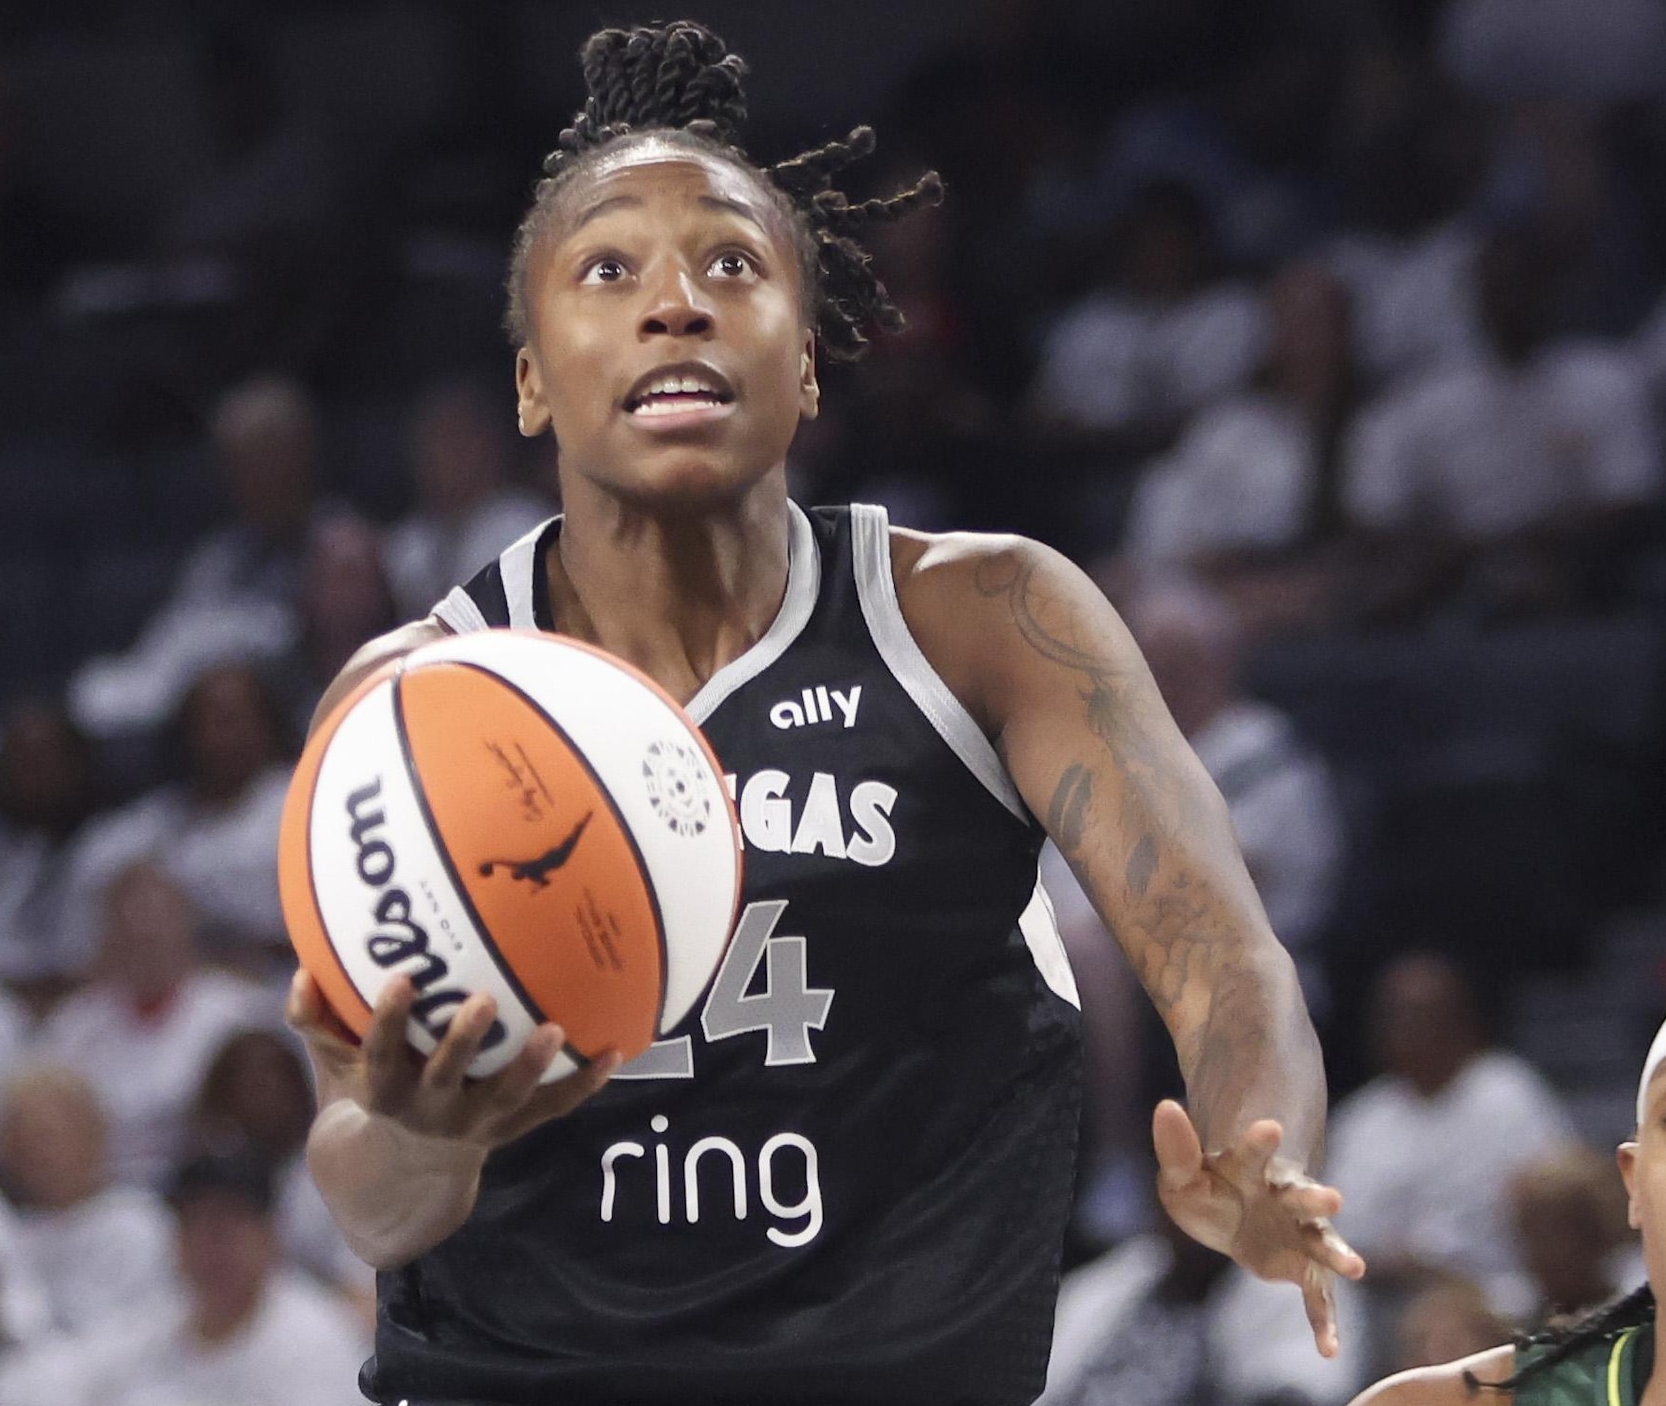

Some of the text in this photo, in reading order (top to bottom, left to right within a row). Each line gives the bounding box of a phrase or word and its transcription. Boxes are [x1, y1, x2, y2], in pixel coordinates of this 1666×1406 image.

[769, 685, 863, 729] ally
[725, 768, 899, 868] GAS
[609, 899, 835, 1078] 4
[601, 1114, 823, 1248] ring
